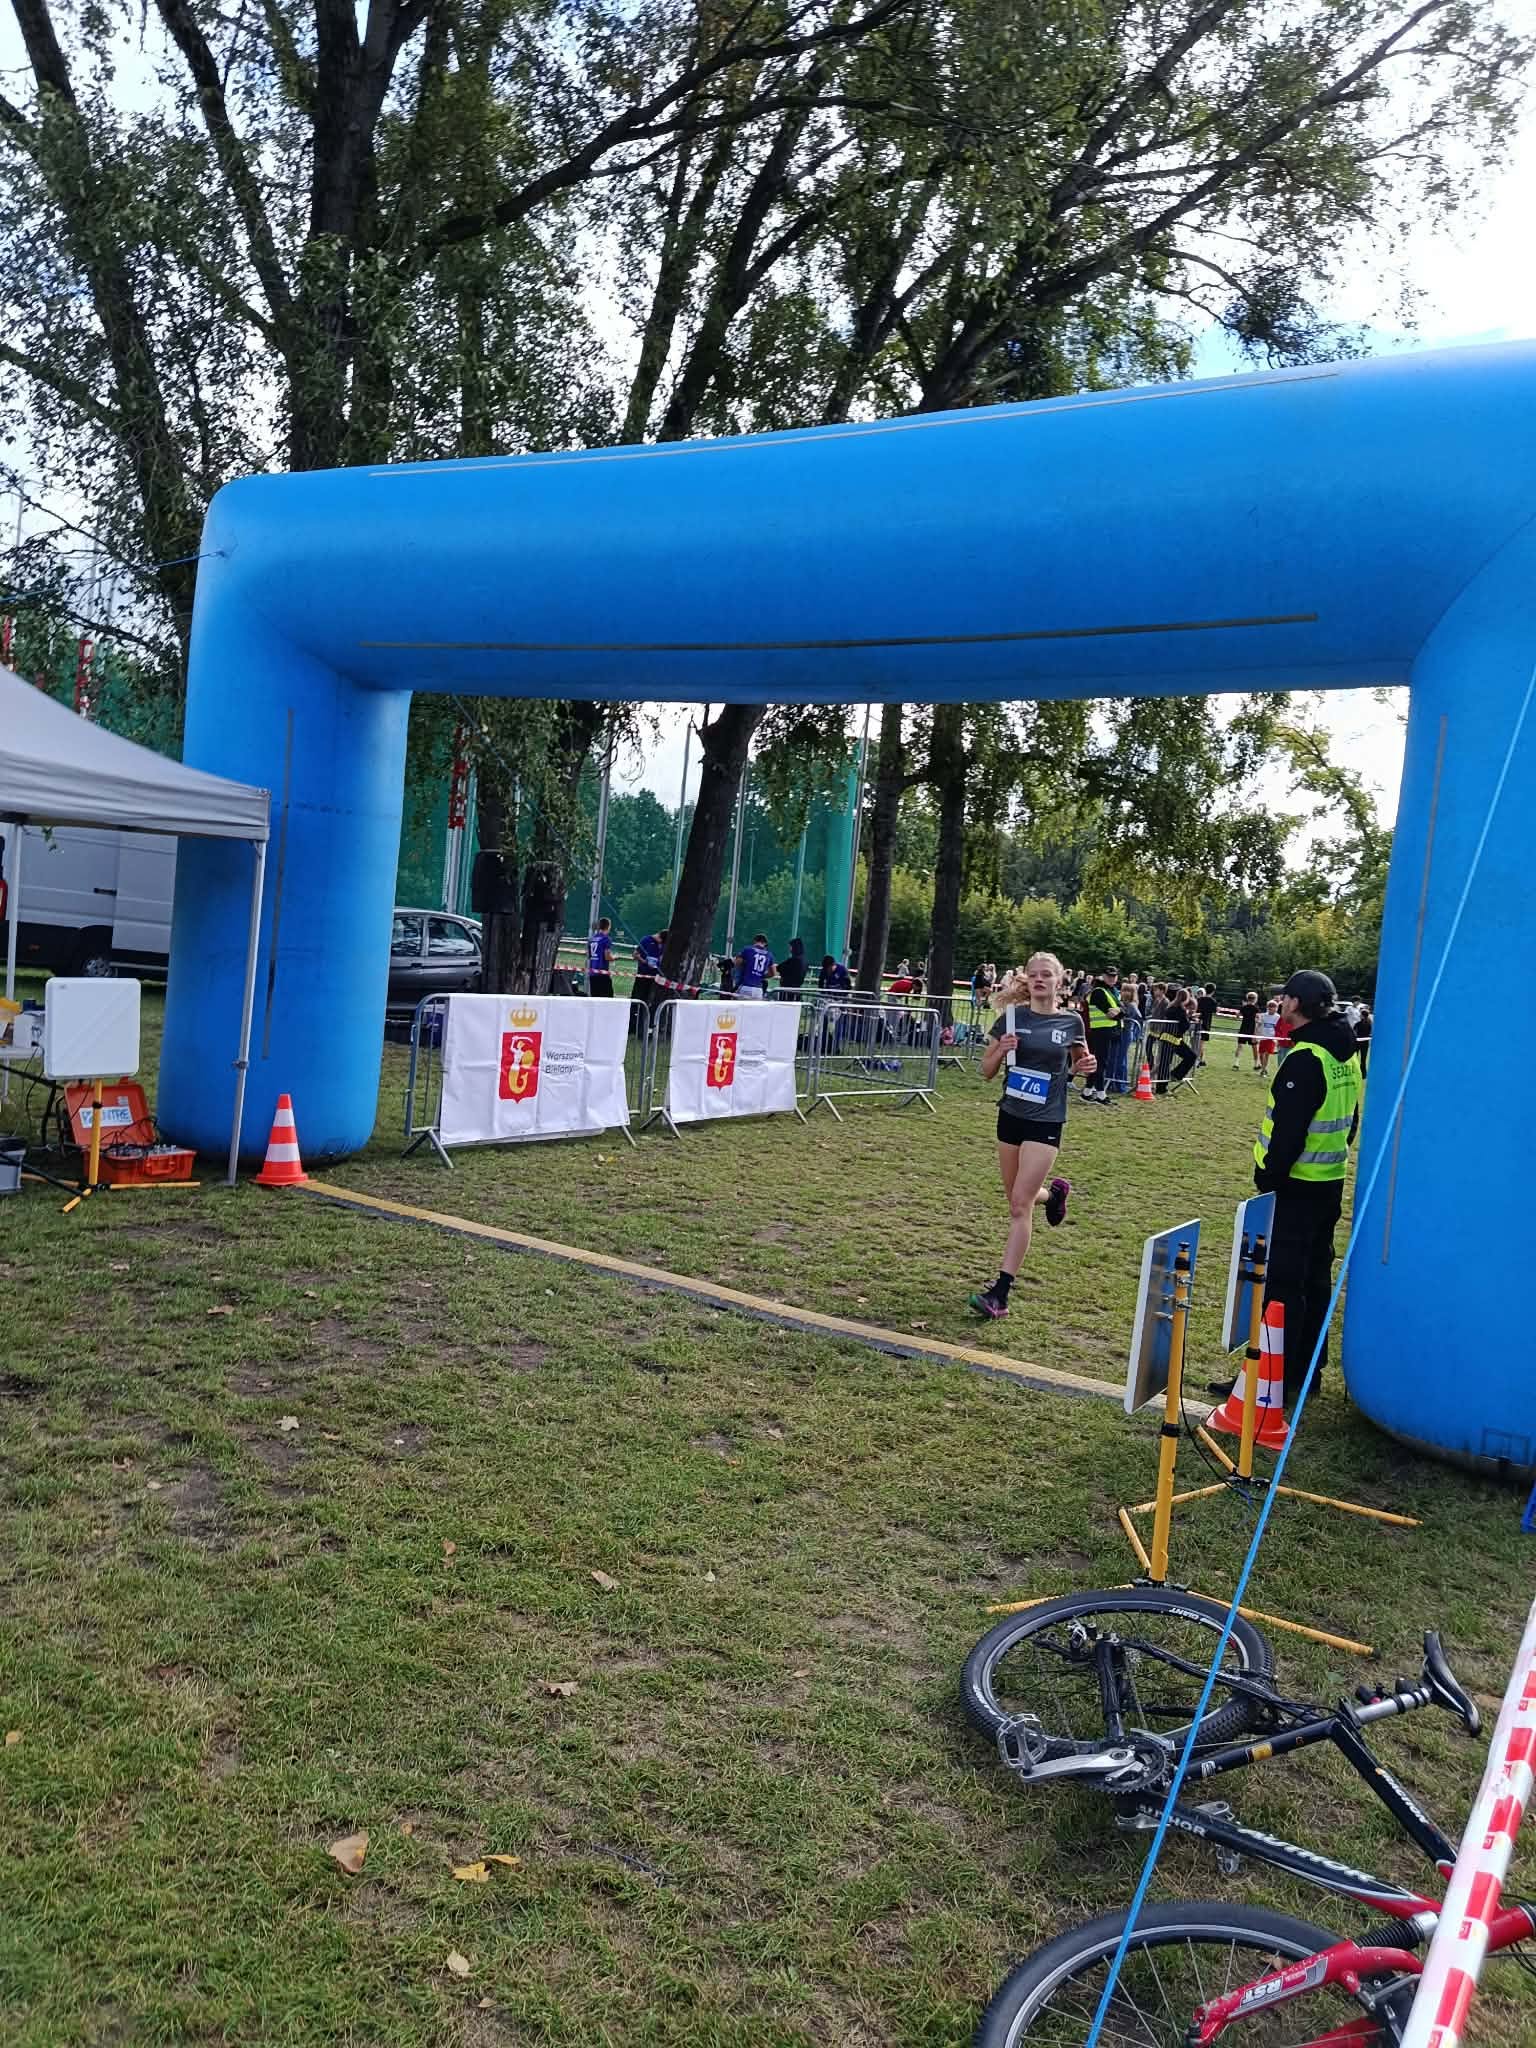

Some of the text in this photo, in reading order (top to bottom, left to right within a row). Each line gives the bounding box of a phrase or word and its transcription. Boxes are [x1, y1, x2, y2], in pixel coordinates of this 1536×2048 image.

[753, 953, 767, 972] 13
[546, 1051, 584, 1060] Warszawa
[545, 1064, 574, 1075] Bielany
[1020, 1076, 1041, 1094] 7/6
[1169, 1607, 1200, 1620] GIANT
[1238, 1828, 1377, 1881] AUTHOR
[1242, 1978, 1281, 2004] RST
